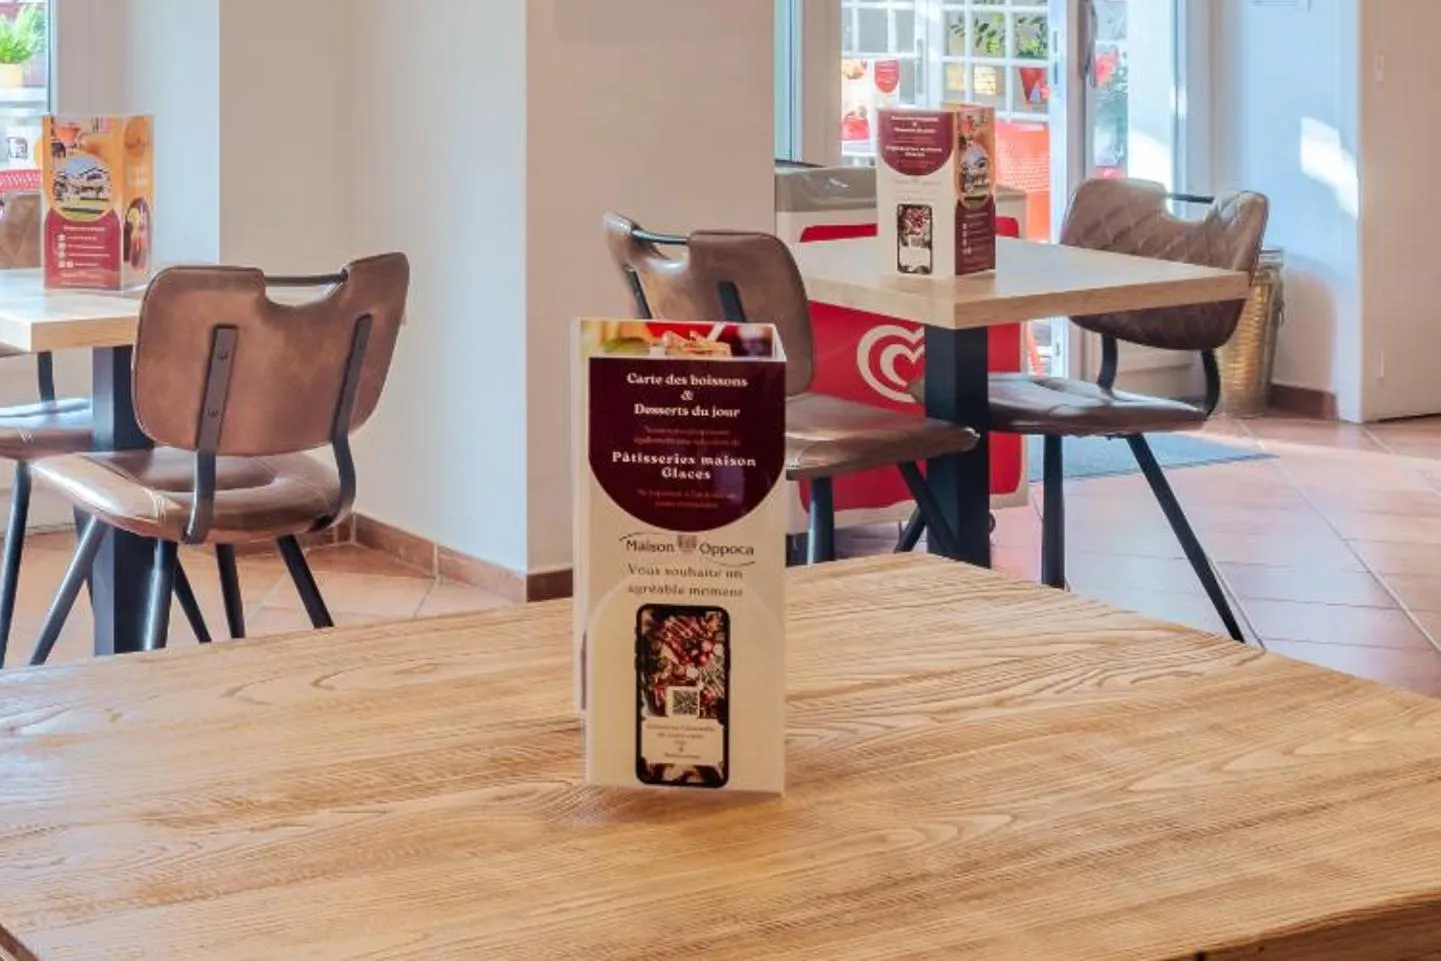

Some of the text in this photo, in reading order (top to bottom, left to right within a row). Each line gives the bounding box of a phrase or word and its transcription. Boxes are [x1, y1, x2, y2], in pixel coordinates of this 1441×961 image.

[626, 372, 748, 387] Carte des boissons
[680, 390, 694, 401] &
[634, 403, 741, 419] Desserts du jour
[612, 451, 757, 467] Pâtisseries maison
[661, 467, 711, 480] Glaces
[626, 539, 755, 556] Maison Oppoca
[627, 563, 743, 579] Vous souhaite un
